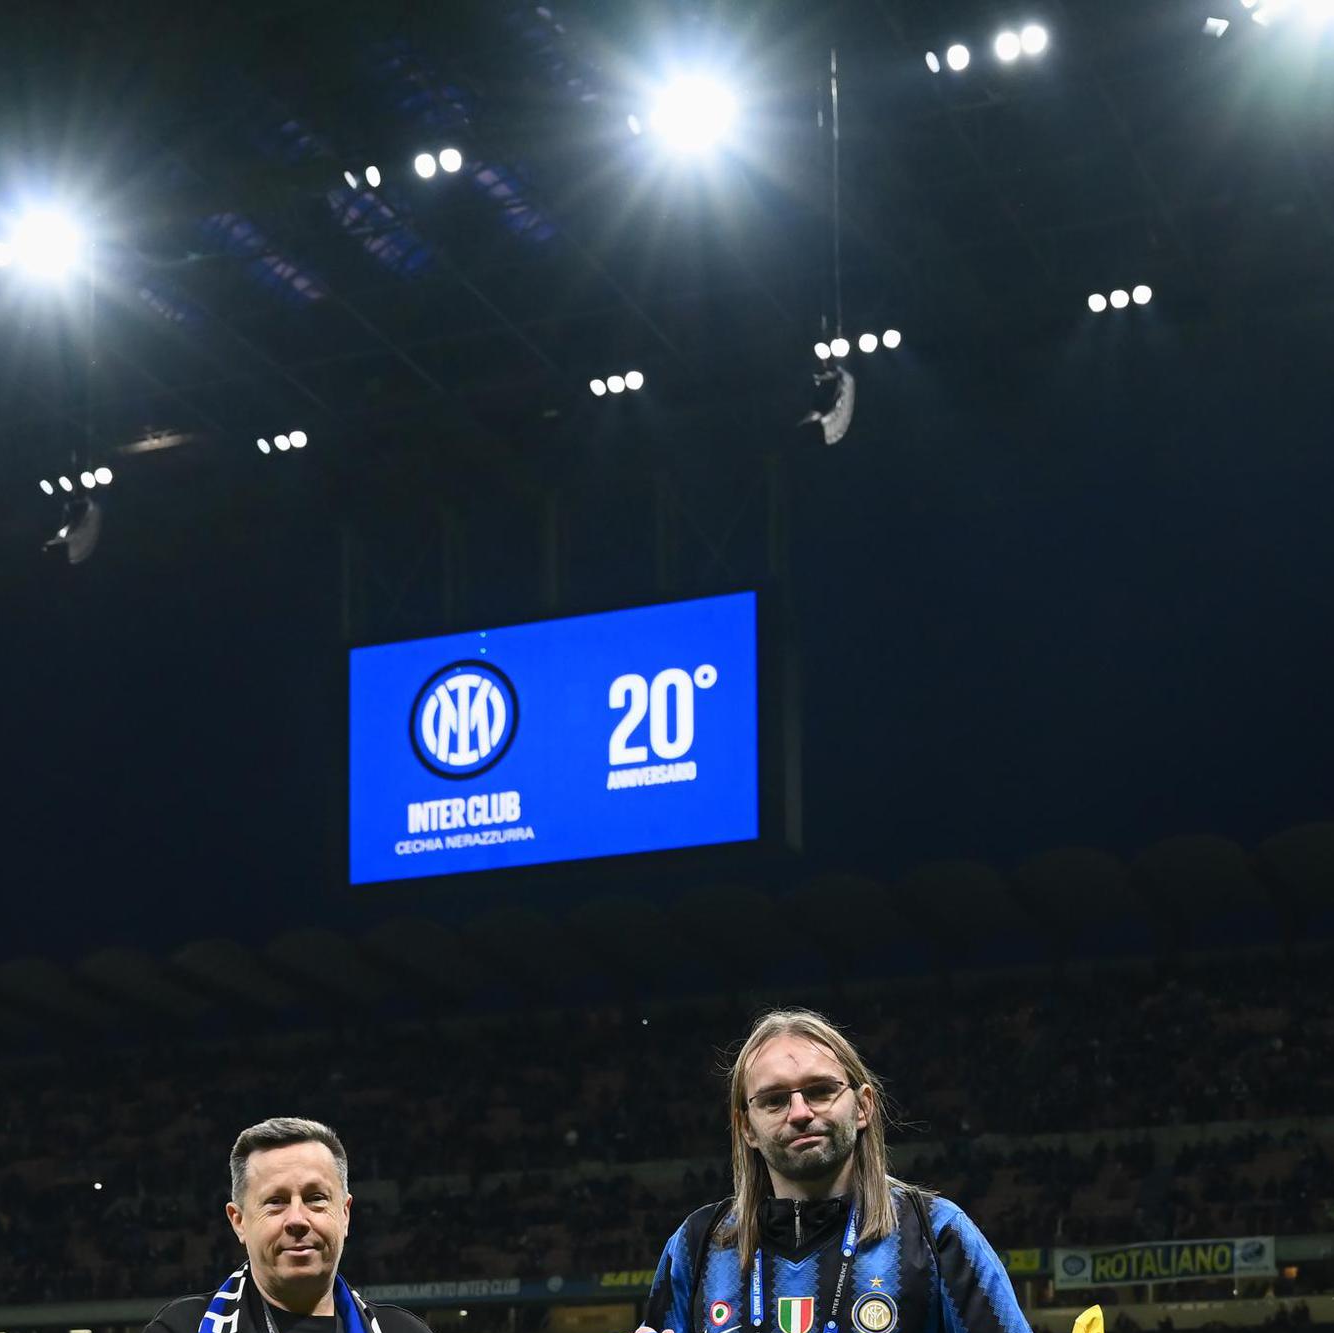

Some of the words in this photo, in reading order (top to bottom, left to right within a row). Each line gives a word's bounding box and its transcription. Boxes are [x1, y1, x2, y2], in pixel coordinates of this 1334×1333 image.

[608, 663, 717, 765] 20°
[607, 760, 697, 790] ANNIVERSARIO
[408, 796, 467, 833] INTER
[467, 791, 522, 826] CLUB
[395, 835, 444, 855] CECHIA
[445, 826, 535, 849] NERAZZURRA
[1093, 1244, 1232, 1281] ROTALIANO
[457, 1281, 488, 1296] INTER
[489, 1278, 521, 1295] CLUB
[831, 1296, 839, 1316] INTER
[835, 1262, 849, 1297] EXPERIENCE
